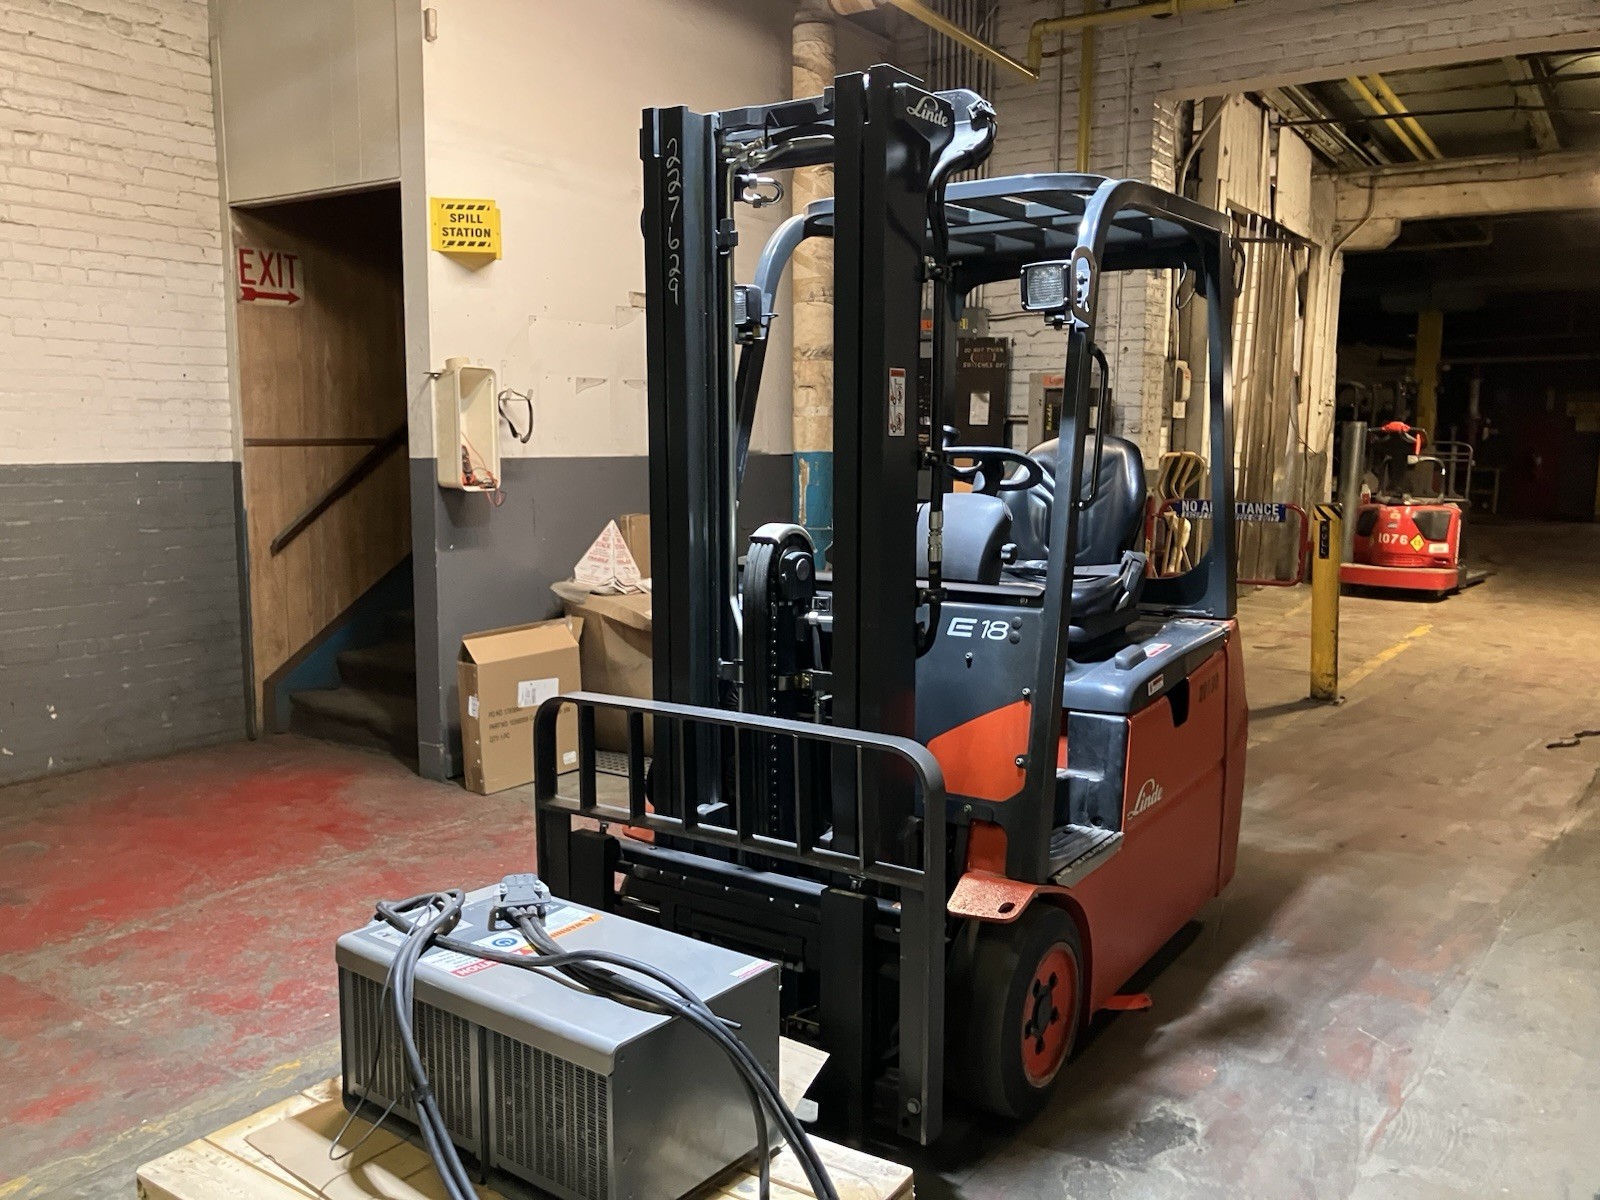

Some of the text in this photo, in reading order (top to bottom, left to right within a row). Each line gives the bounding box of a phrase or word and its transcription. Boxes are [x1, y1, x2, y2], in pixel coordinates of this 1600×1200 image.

[906, 95, 949, 128] Linde
[449, 213, 483, 224] SPILL
[442, 227, 491, 238] STATION
[239, 248, 298, 289] EXIT
[1181, 500, 1199, 513] NO
[1378, 533, 1409, 546] 1076
[946, 617, 1010, 640] E 18
[1127, 778, 1163, 821] Linde
